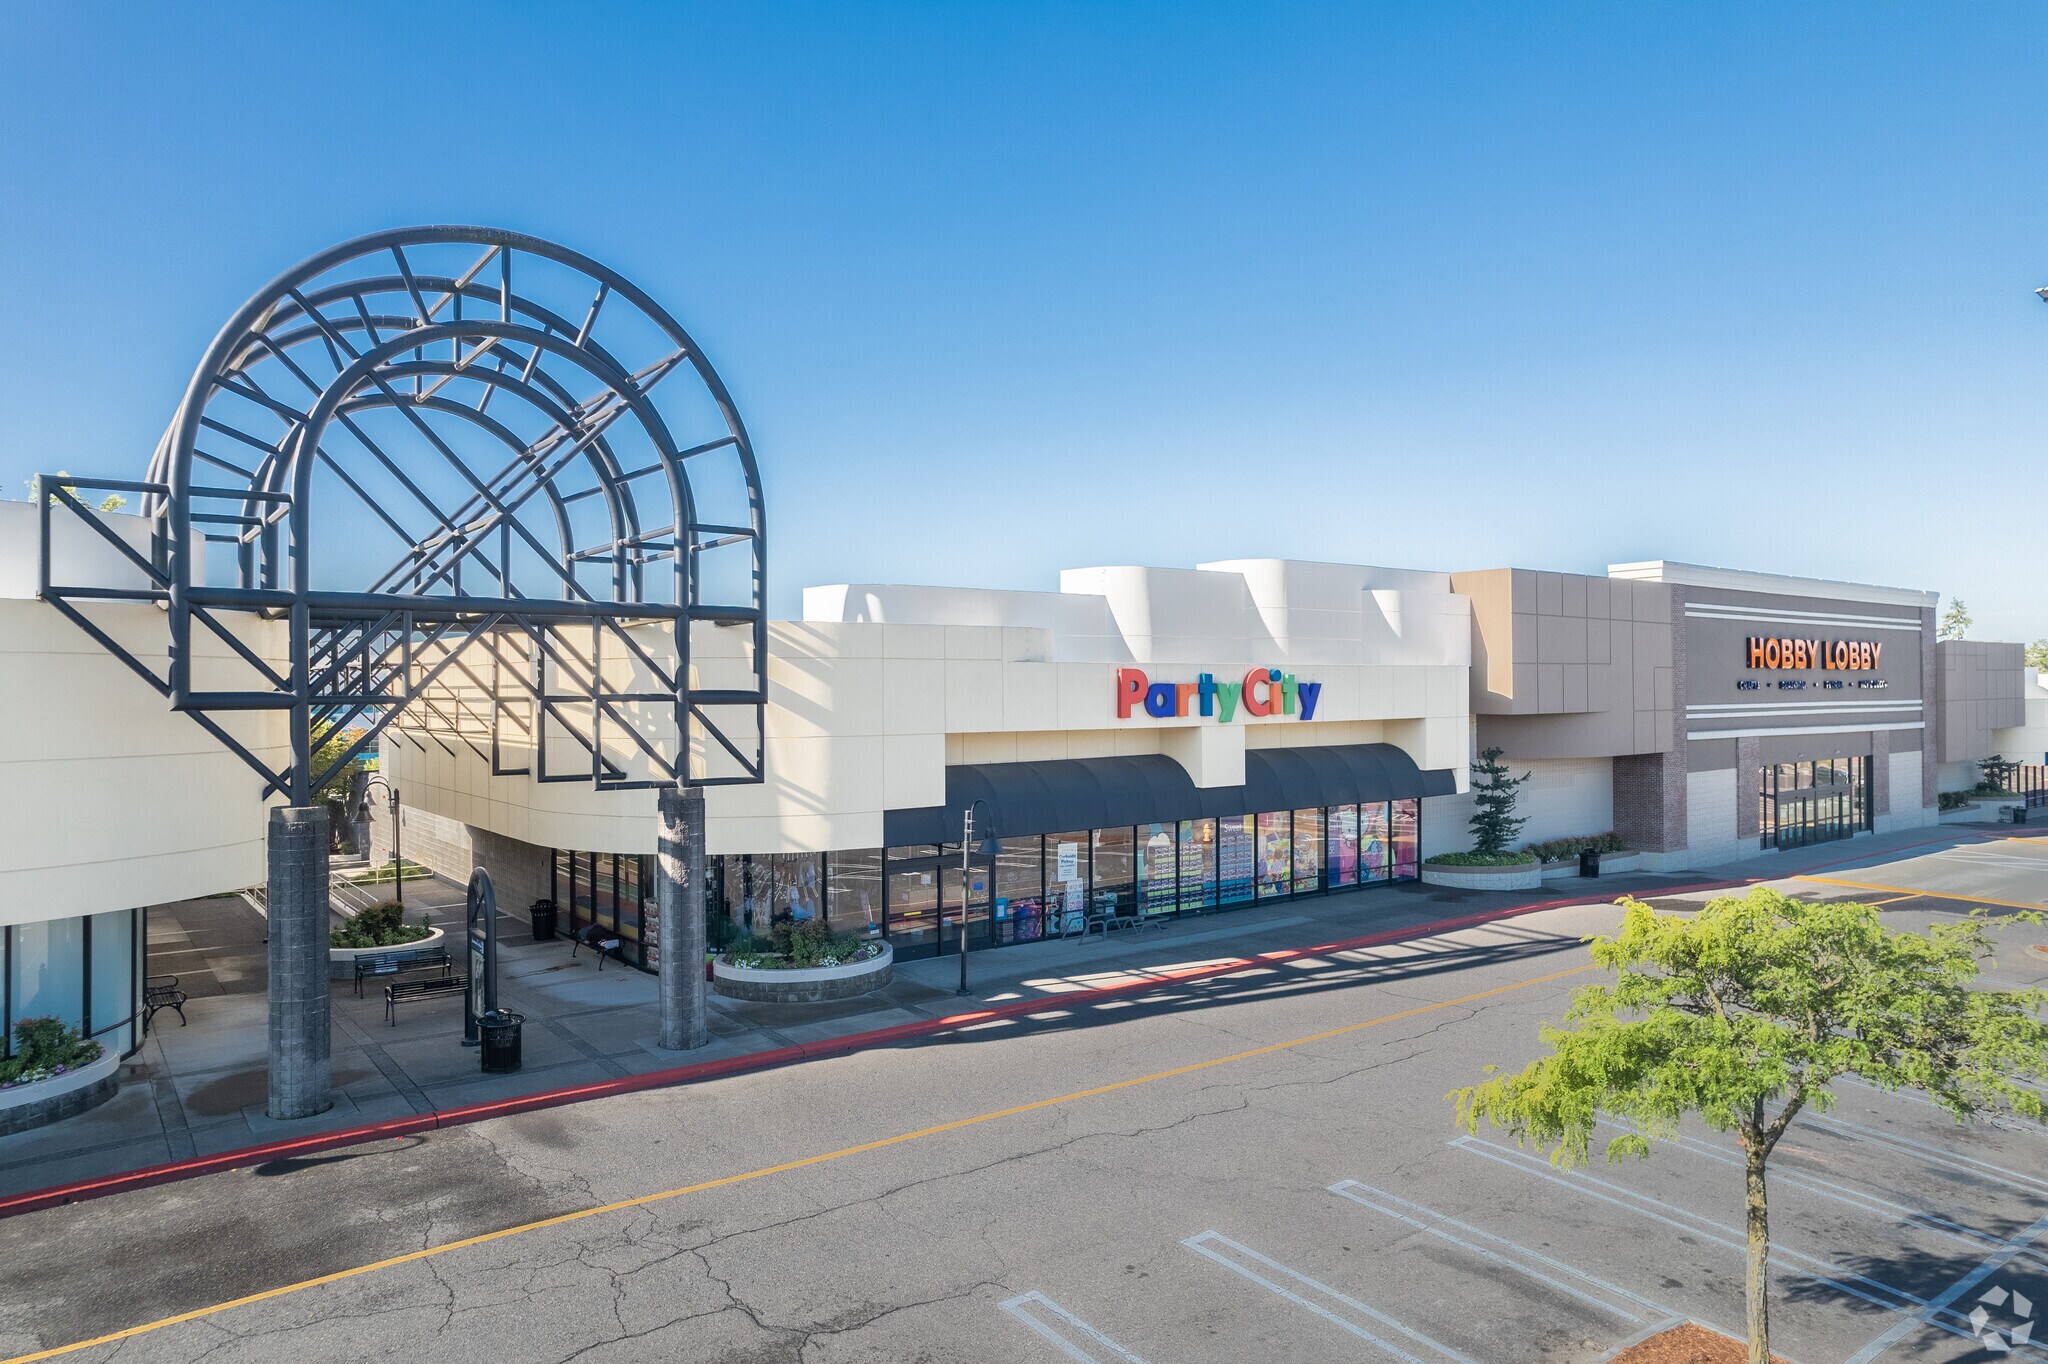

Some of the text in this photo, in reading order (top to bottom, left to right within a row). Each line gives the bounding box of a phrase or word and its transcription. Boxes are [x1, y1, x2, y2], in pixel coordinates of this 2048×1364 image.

[1746, 637, 1882, 670] HOBBY LOBBY
[1117, 667, 1322, 722] Party City
